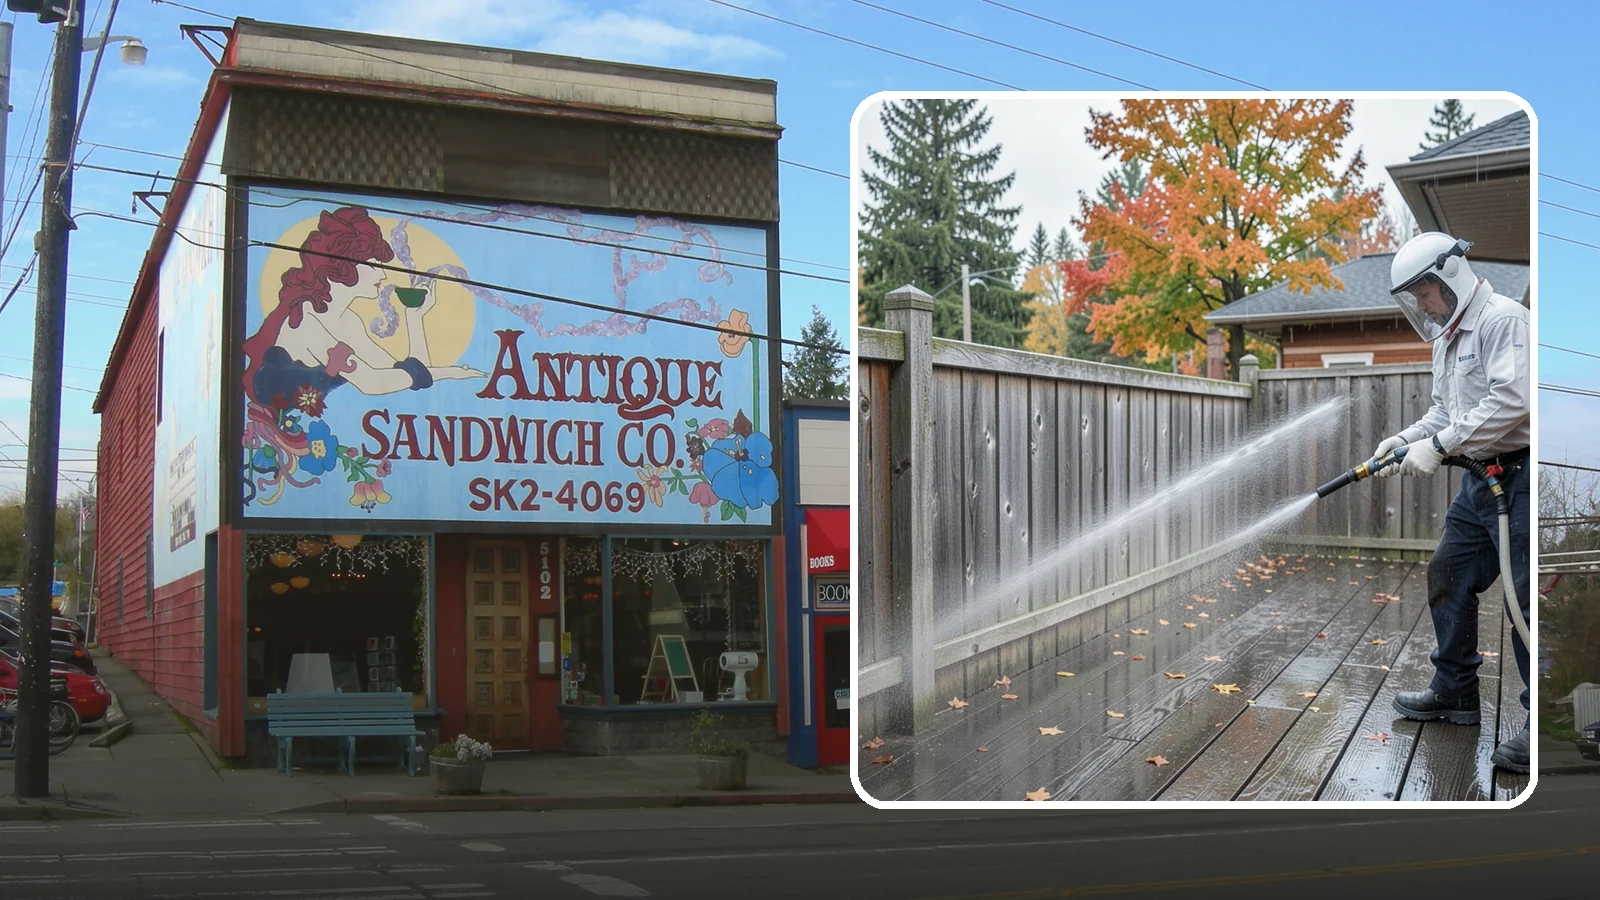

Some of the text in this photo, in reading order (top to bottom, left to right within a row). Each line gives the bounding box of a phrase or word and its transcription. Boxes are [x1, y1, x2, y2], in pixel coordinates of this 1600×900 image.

[476, 330, 723, 421] ANTIQUE
[361, 409, 685, 470] SANDWICH CO.
[468, 477, 646, 514] SK2-4069
[539, 541, 552, 600] 5102
[809, 555, 835, 569] BOOKS
